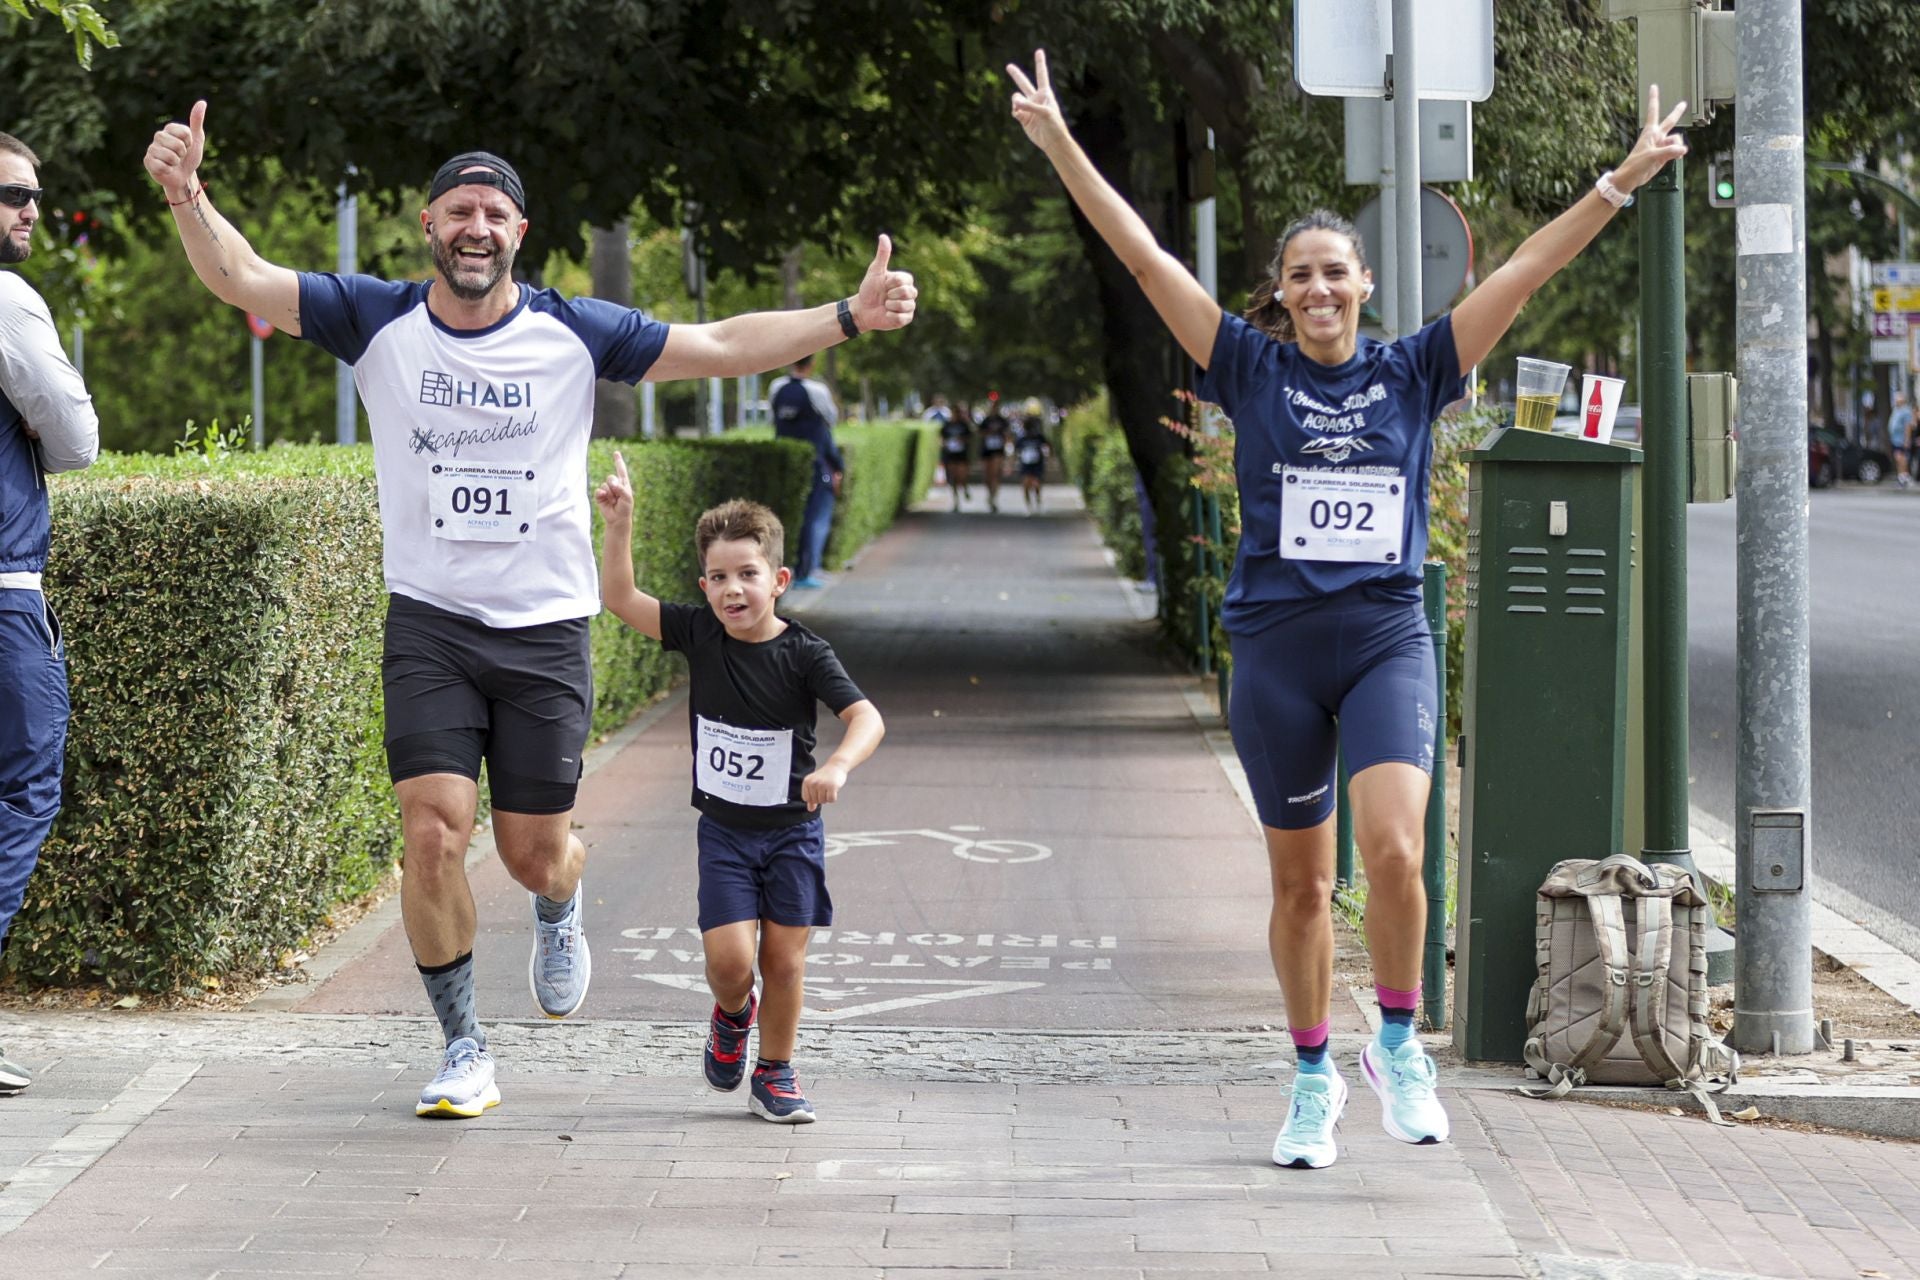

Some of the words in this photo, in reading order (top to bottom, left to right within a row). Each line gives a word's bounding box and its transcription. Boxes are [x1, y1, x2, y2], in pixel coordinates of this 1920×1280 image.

[457, 381, 531, 408] HABI
[1272, 462, 1282, 474] EL
[1349, 481, 1386, 489] SOLIDARIA
[451, 486, 512, 515] 091
[1310, 499, 1374, 532] 092
[712, 728, 739, 739] CARRERA
[740, 734, 776, 742] SOLIDARIA
[709, 746, 765, 781] 052
[620, 928, 1118, 949] PRIORID
[612, 948, 1112, 971] PEATOAL
